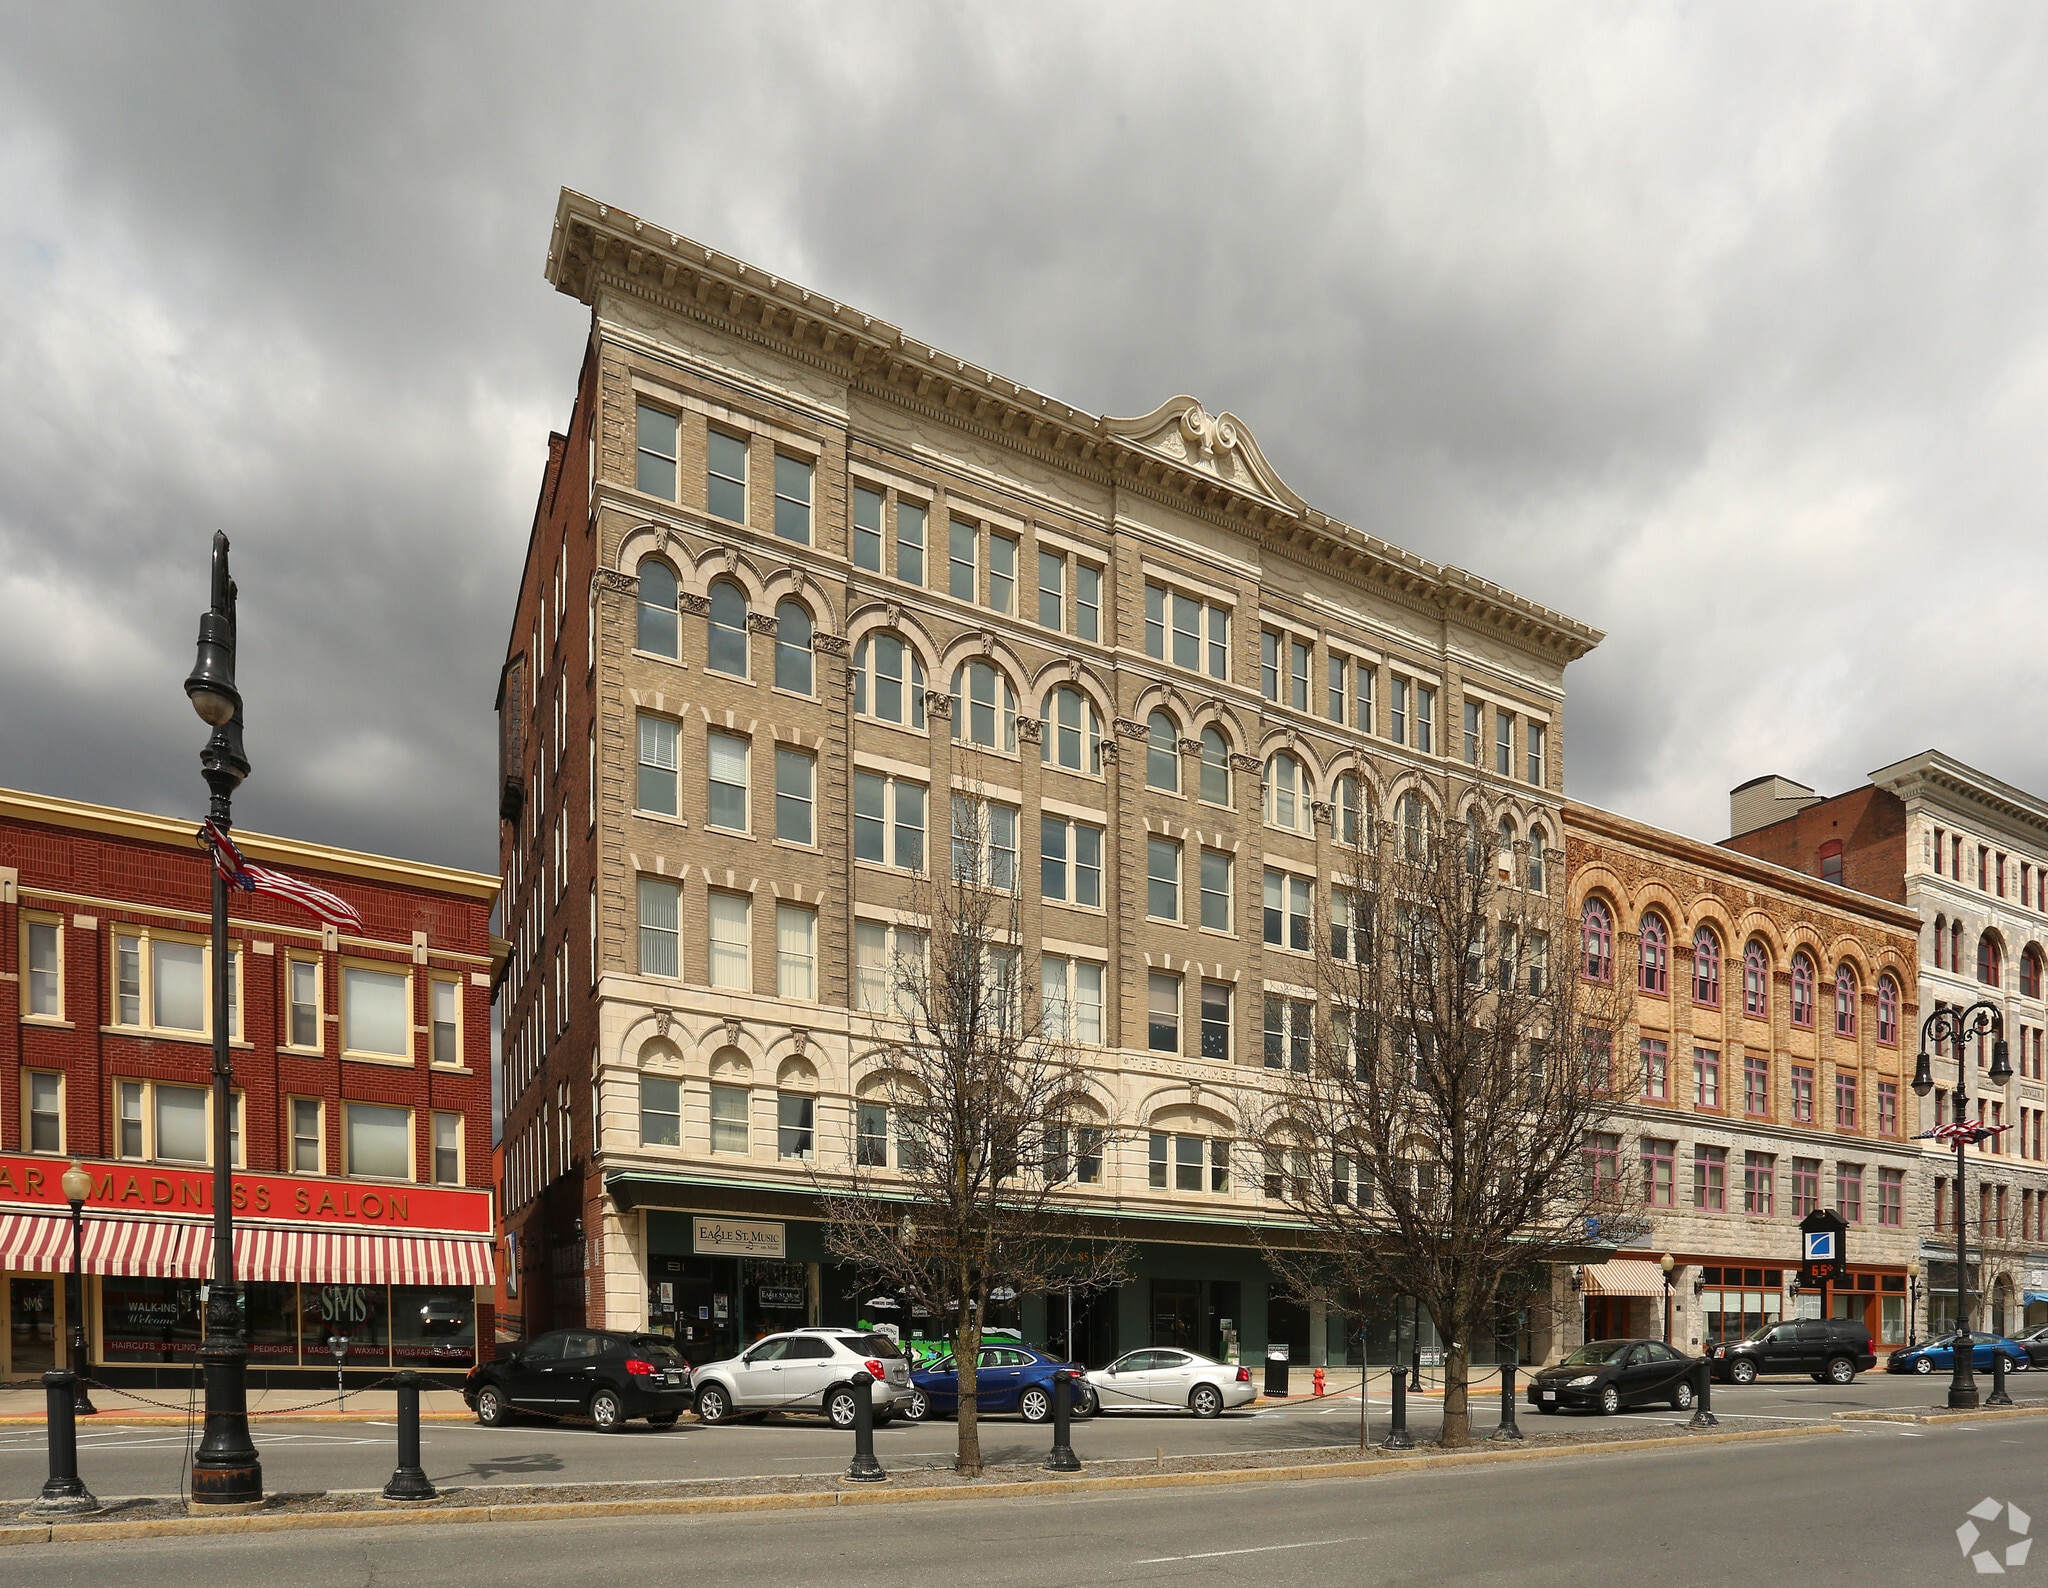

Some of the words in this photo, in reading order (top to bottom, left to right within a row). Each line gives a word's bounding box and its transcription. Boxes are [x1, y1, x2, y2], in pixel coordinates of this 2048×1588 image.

[1130, 1057, 1158, 1071] THE
[1165, 1063, 1192, 1076] NEW
[87, 1173, 271, 1211] MADNSS
[295, 1187, 408, 1220] SALON
[23, 1296, 43, 1312] SMS
[128, 1301, 177, 1313] WALK-INS
[320, 1285, 367, 1323] SMS
[127, 1313, 176, 1325] Welcome
[111, 1341, 156, 1350] HAIRCUTS
[161, 1343, 197, 1352] STYLING
[253, 1344, 294, 1353] PEDICURE
[354, 1347, 385, 1355] WAXING
[395, 1347, 416, 1356] WIGS
